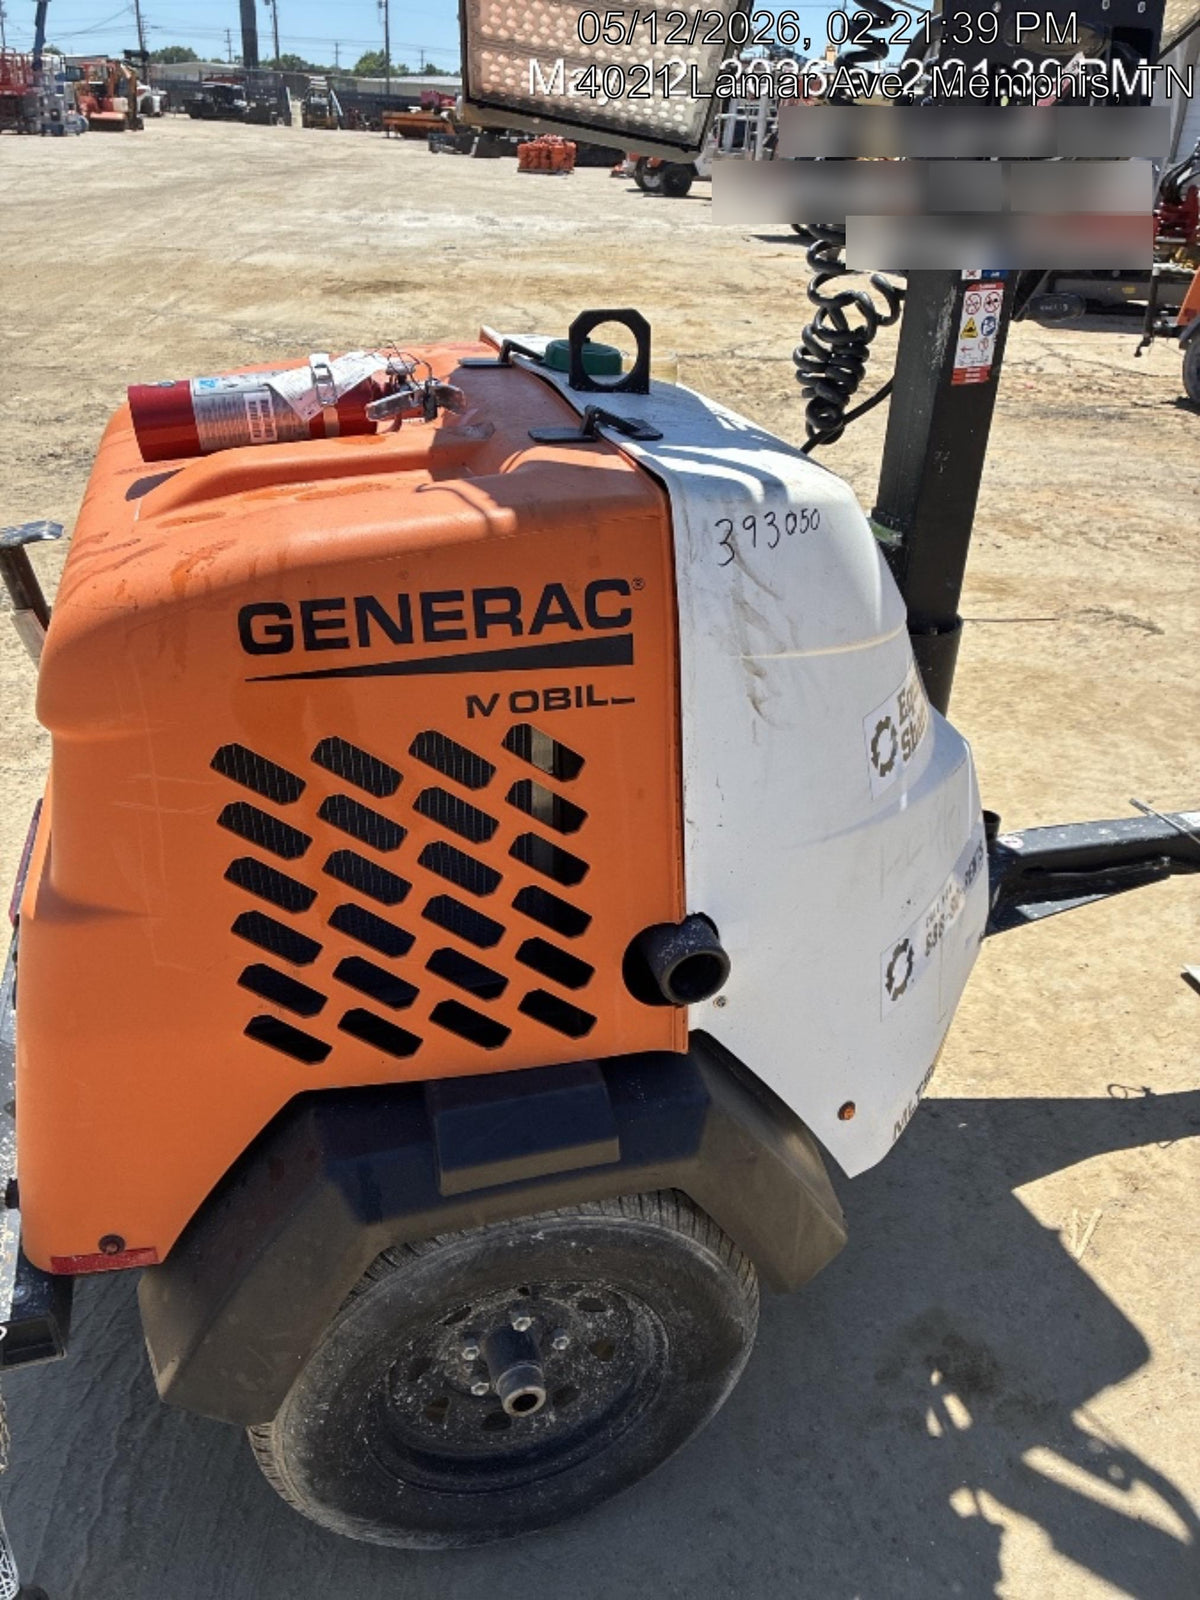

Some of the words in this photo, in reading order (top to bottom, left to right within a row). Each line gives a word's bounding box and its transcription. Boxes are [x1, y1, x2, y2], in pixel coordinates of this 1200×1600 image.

[714, 506, 821, 568] 393050
[238, 578, 633, 656] GENERAC
[465, 684, 636, 719] MOBIL
